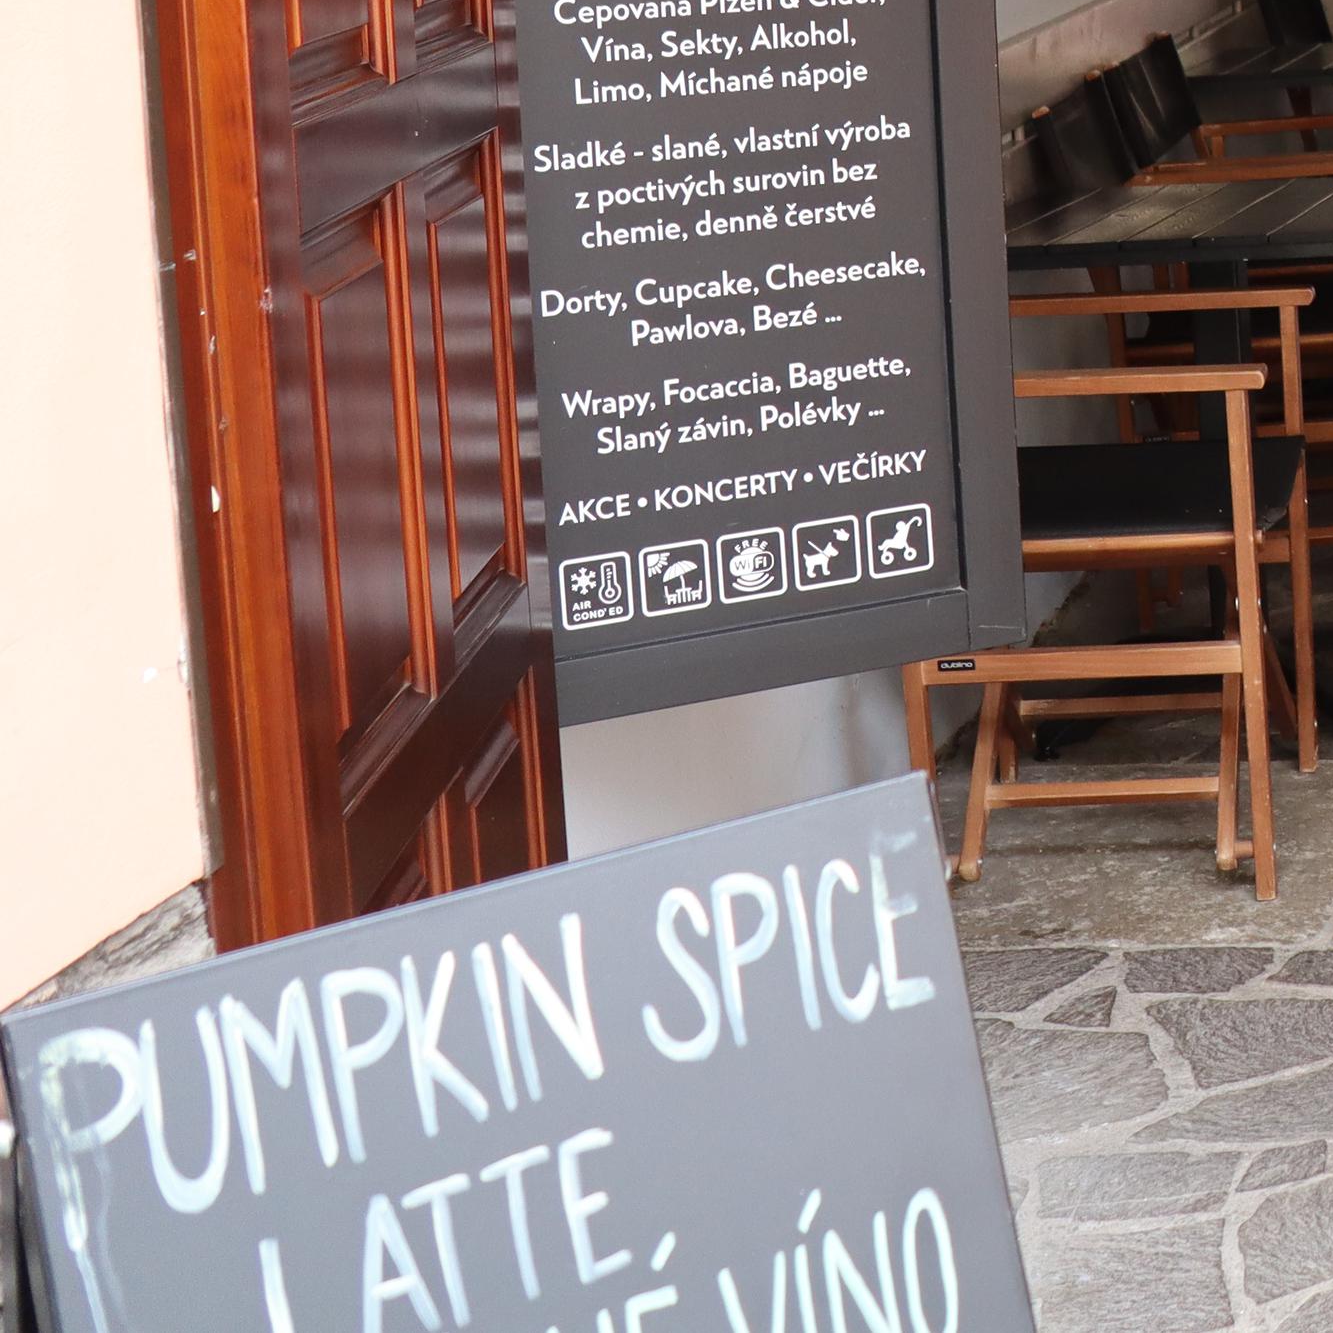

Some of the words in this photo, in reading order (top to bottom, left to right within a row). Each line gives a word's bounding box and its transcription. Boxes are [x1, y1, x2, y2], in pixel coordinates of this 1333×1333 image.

[580, 35, 653, 63] Vína,
[660, 28, 744, 60] Sekty,
[750, 18, 857, 51] Alkohol,
[574, 77, 652, 105] Limo,
[660, 65, 774, 98] Míchané
[781, 60, 868, 92] nápoje
[534, 140, 626, 173] Sladké
[651, 132, 728, 162] slané,
[733, 123, 820, 154] vlastní
[824, 114, 911, 151] výroba
[574, 191, 590, 210] z
[597, 169, 726, 214] poctivých
[732, 164, 826, 194] surovin
[832, 157, 878, 184] bez
[581, 218, 689, 249] chemie,
[695, 204, 778, 237] denně
[784, 195, 876, 227] čerstvé
[540, 289, 628, 318] Dorty,
[635, 269, 760, 309] Cupcake,
[765, 250, 926, 291] Cheesecake,
[631, 313, 746, 347] Pawlova,
[753, 301, 818, 332] Bezé
[560, 389, 656, 419] Wrapy,
[663, 371, 782, 406] Focaccia,
[788, 356, 911, 391] Baguette,
[597, 421, 672, 455] Slaný
[677, 414, 753, 444] závin,
[760, 395, 862, 432] Polévky
[558, 493, 631, 526] AKCE
[654, 468, 798, 512] KONCERTY
[818, 449, 927, 485] VEČÍRKY
[734, 538, 769, 555] FREE
[571, 599, 592, 612] AIR
[37, 912, 605, 1239] PUMPKIN
[642, 828, 938, 1062] SPICE
